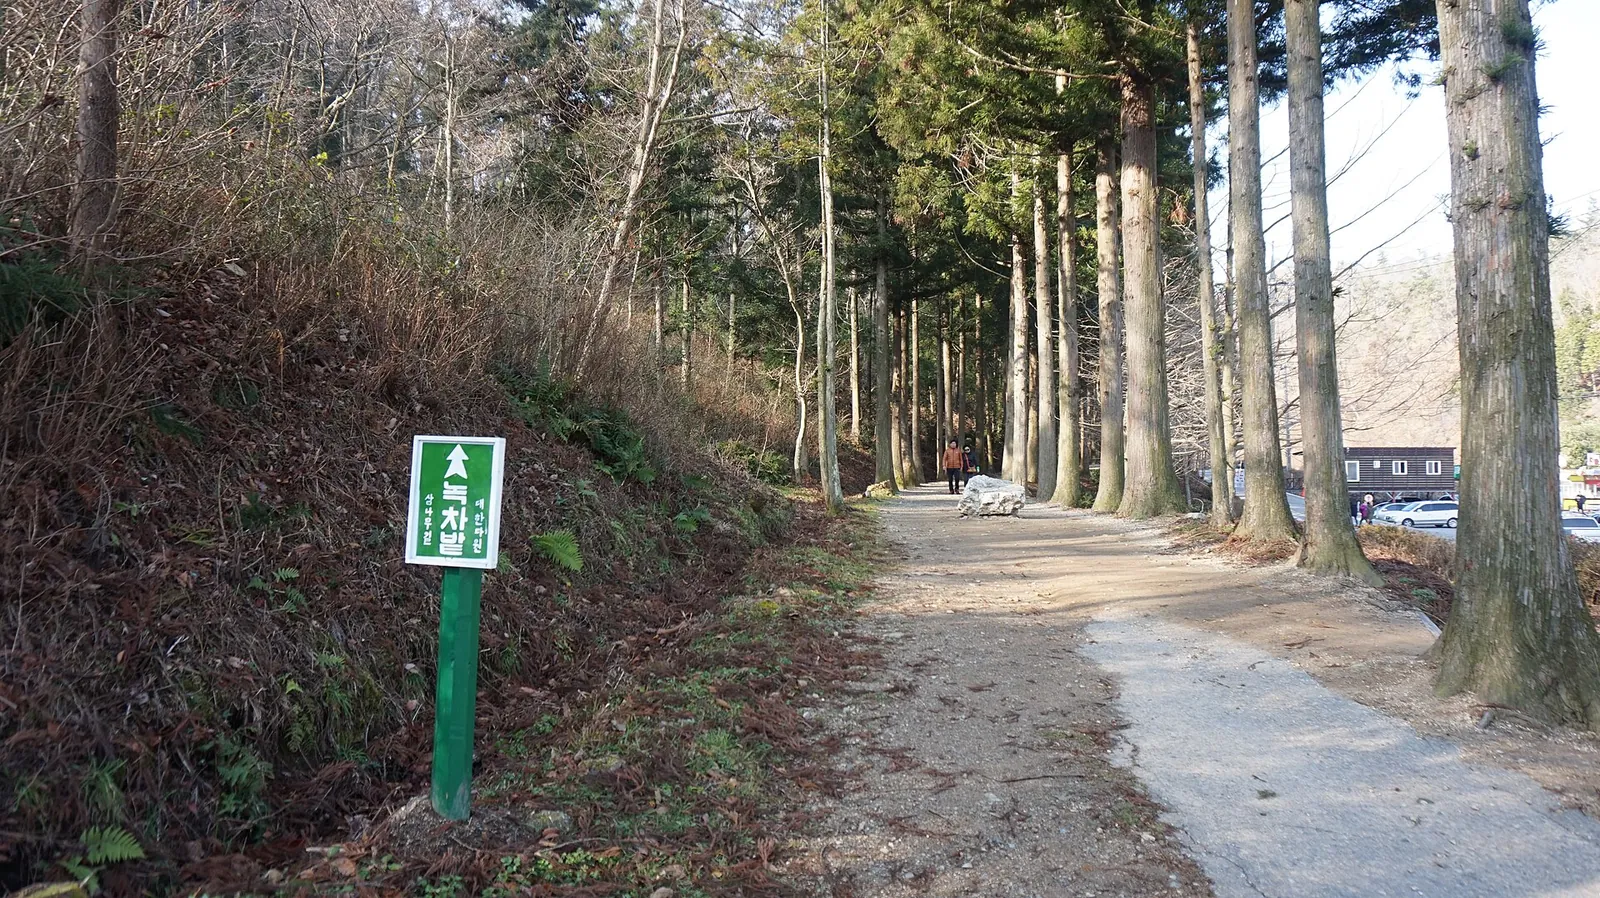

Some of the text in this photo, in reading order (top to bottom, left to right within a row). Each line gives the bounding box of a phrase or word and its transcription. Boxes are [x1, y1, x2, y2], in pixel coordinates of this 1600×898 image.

[423, 493, 434, 546] 삼나무길
[439, 480, 469, 556] 녹차밭
[472, 498, 485, 554] 대한다원
